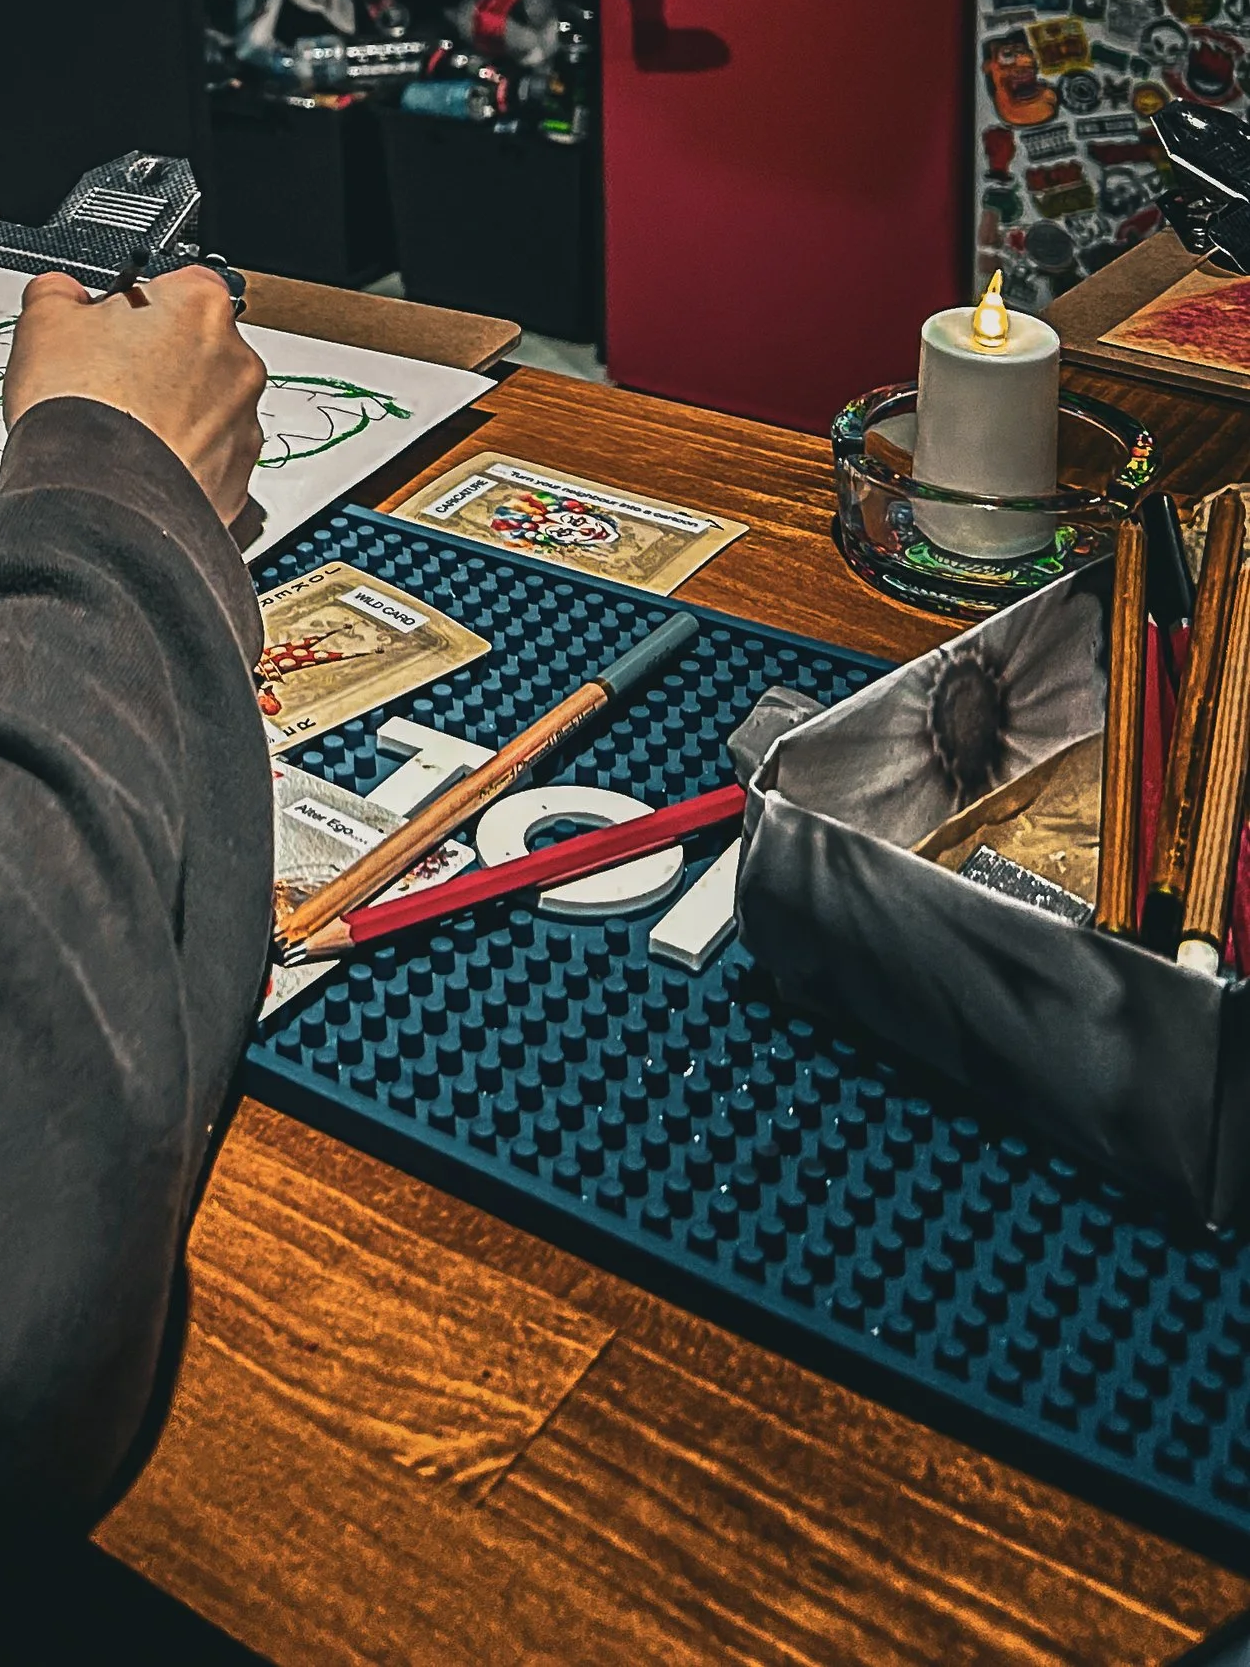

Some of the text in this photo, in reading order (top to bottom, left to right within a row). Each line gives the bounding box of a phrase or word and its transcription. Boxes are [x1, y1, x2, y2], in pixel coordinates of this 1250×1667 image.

[435, 478, 489, 515] CARICATURE
[510, 470, 535, 483] Turn
[535, 479, 562, 491] your
[561, 487, 619, 507] neighbour
[618, 501, 642, 513] into
[653, 512, 699, 529] cartoon
[354, 590, 417, 627] WILD CARD
[294, 803, 327, 823] Alter
